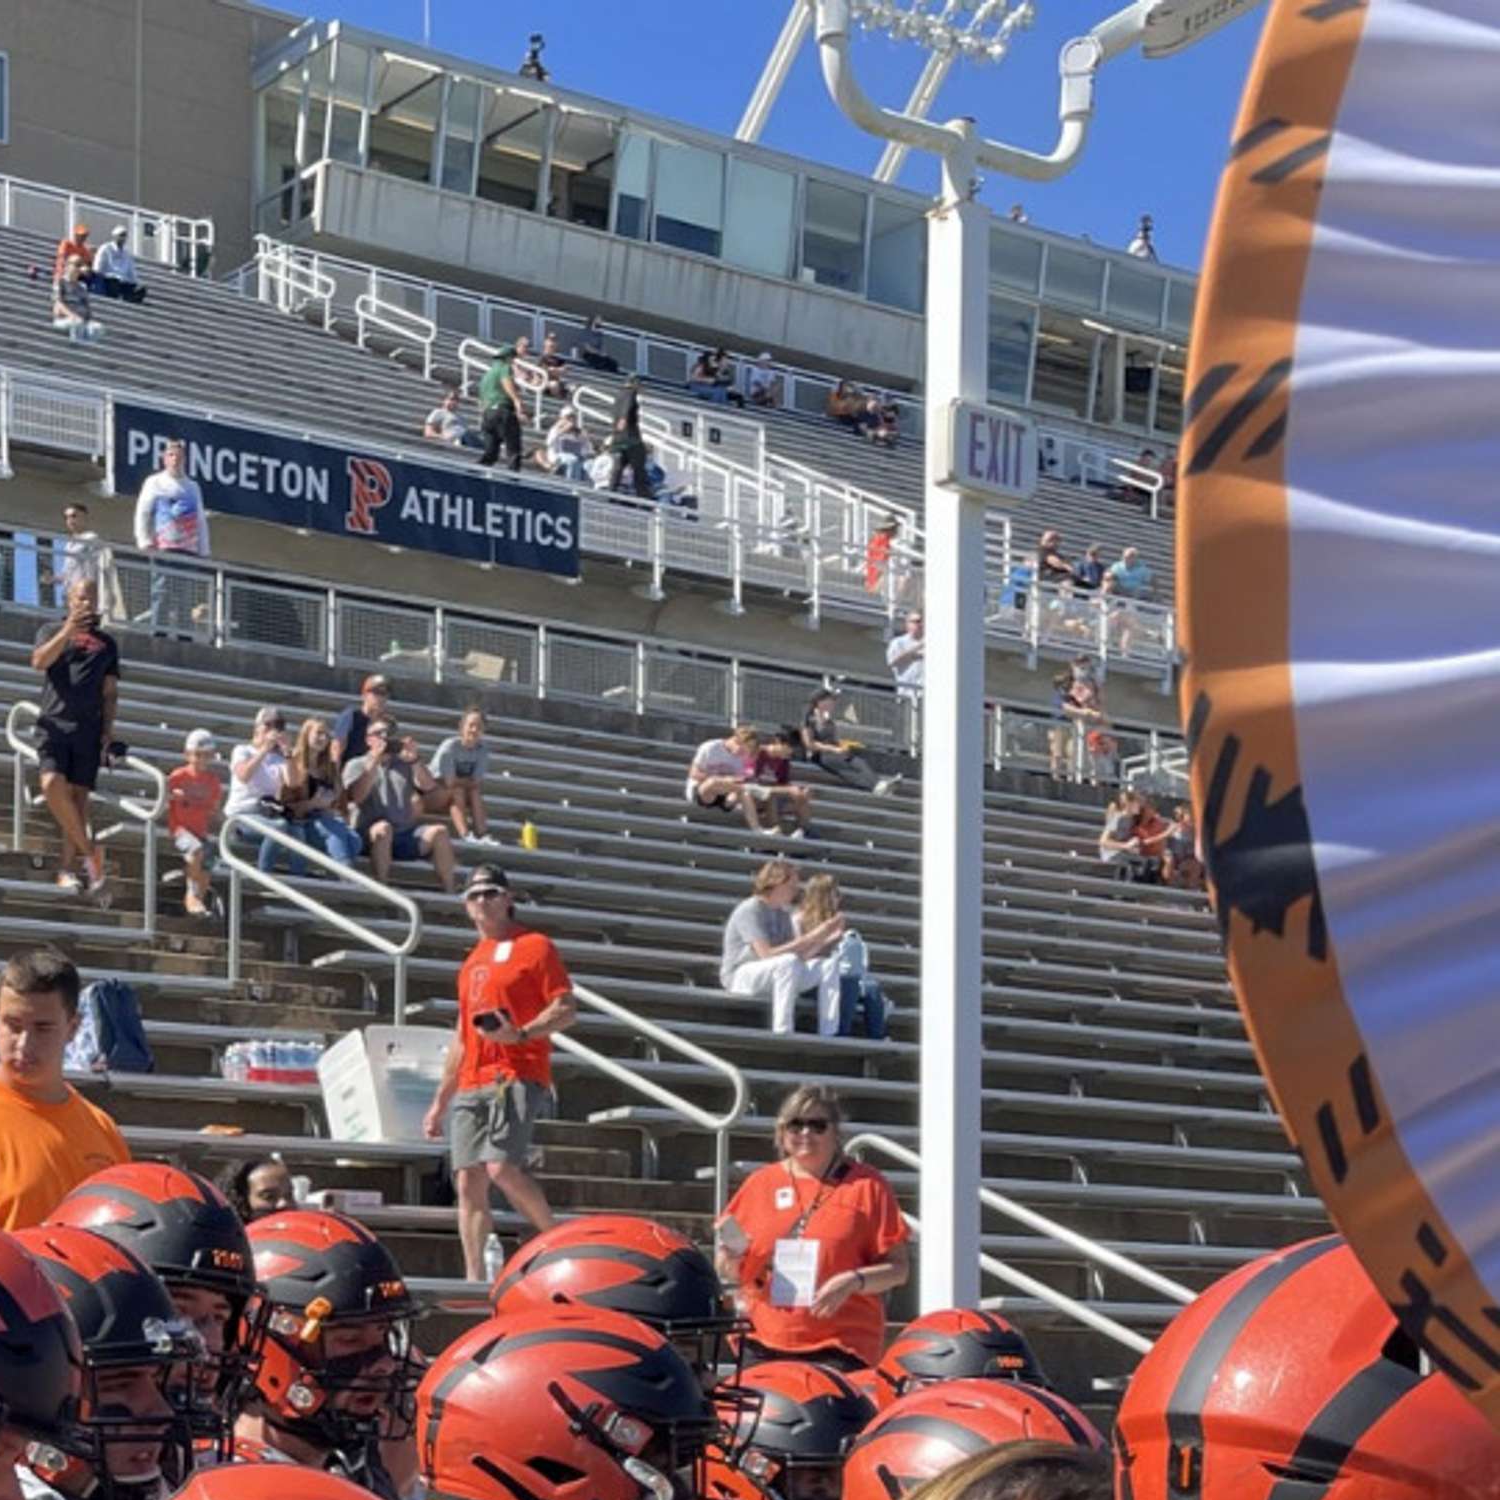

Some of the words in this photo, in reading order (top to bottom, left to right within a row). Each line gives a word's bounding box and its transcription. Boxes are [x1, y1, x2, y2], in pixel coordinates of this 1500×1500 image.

[127, 430, 329, 504] PRNCETON
[401, 487, 574, 550] ATHLETICS
[969, 411, 1026, 488] EXIT
